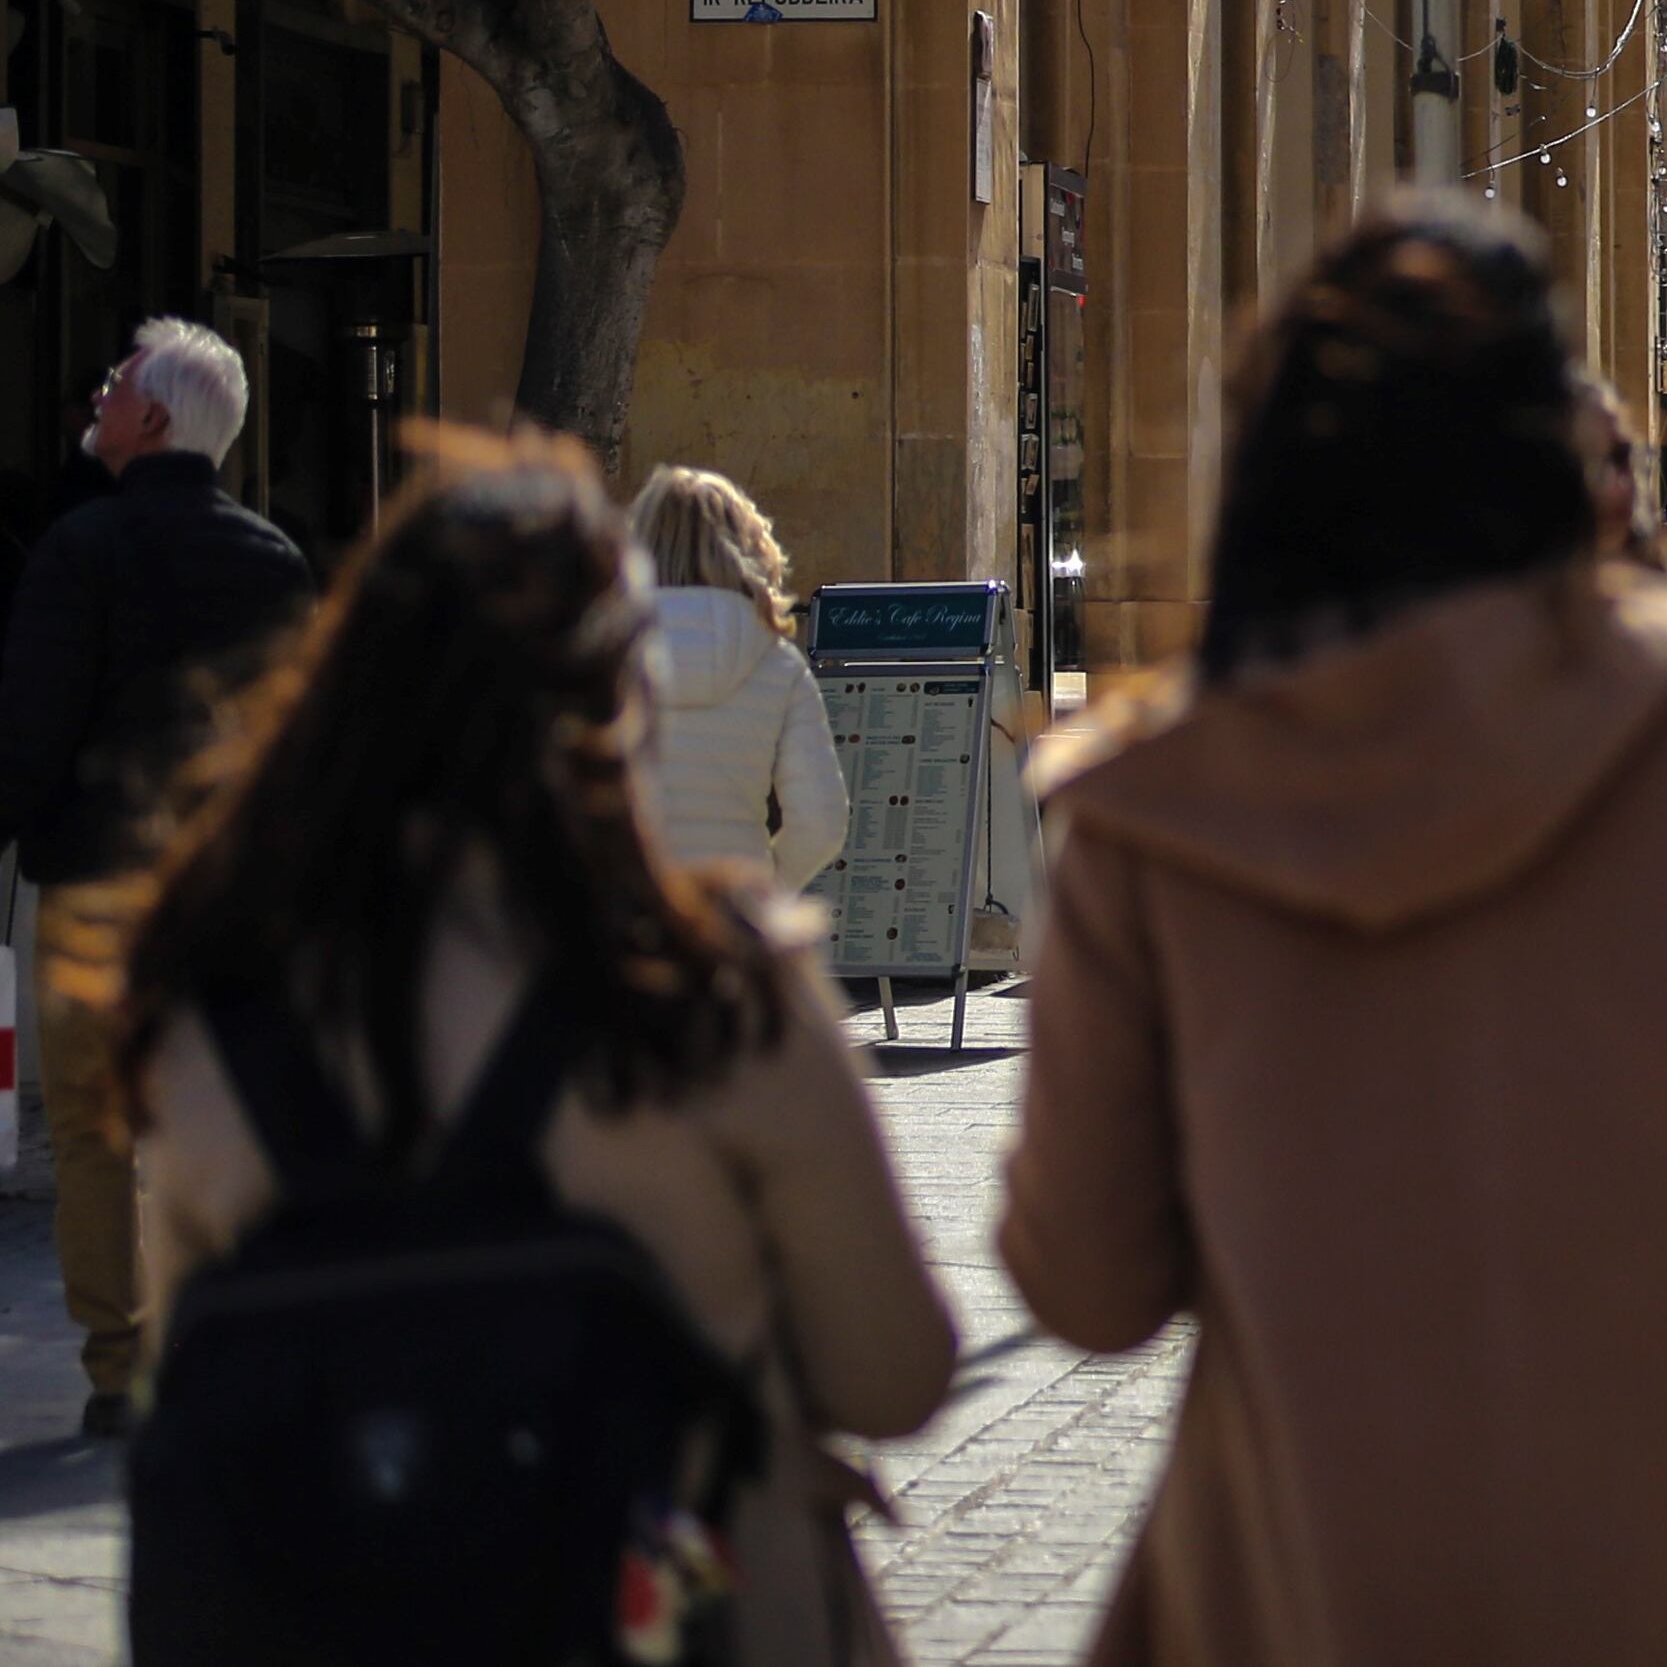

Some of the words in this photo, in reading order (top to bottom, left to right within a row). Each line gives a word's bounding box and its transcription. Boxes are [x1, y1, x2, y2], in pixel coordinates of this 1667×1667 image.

[828, 606, 881, 626] Eddie's
[888, 604, 922, 627] Cafe
[925, 604, 982, 631] Regina
